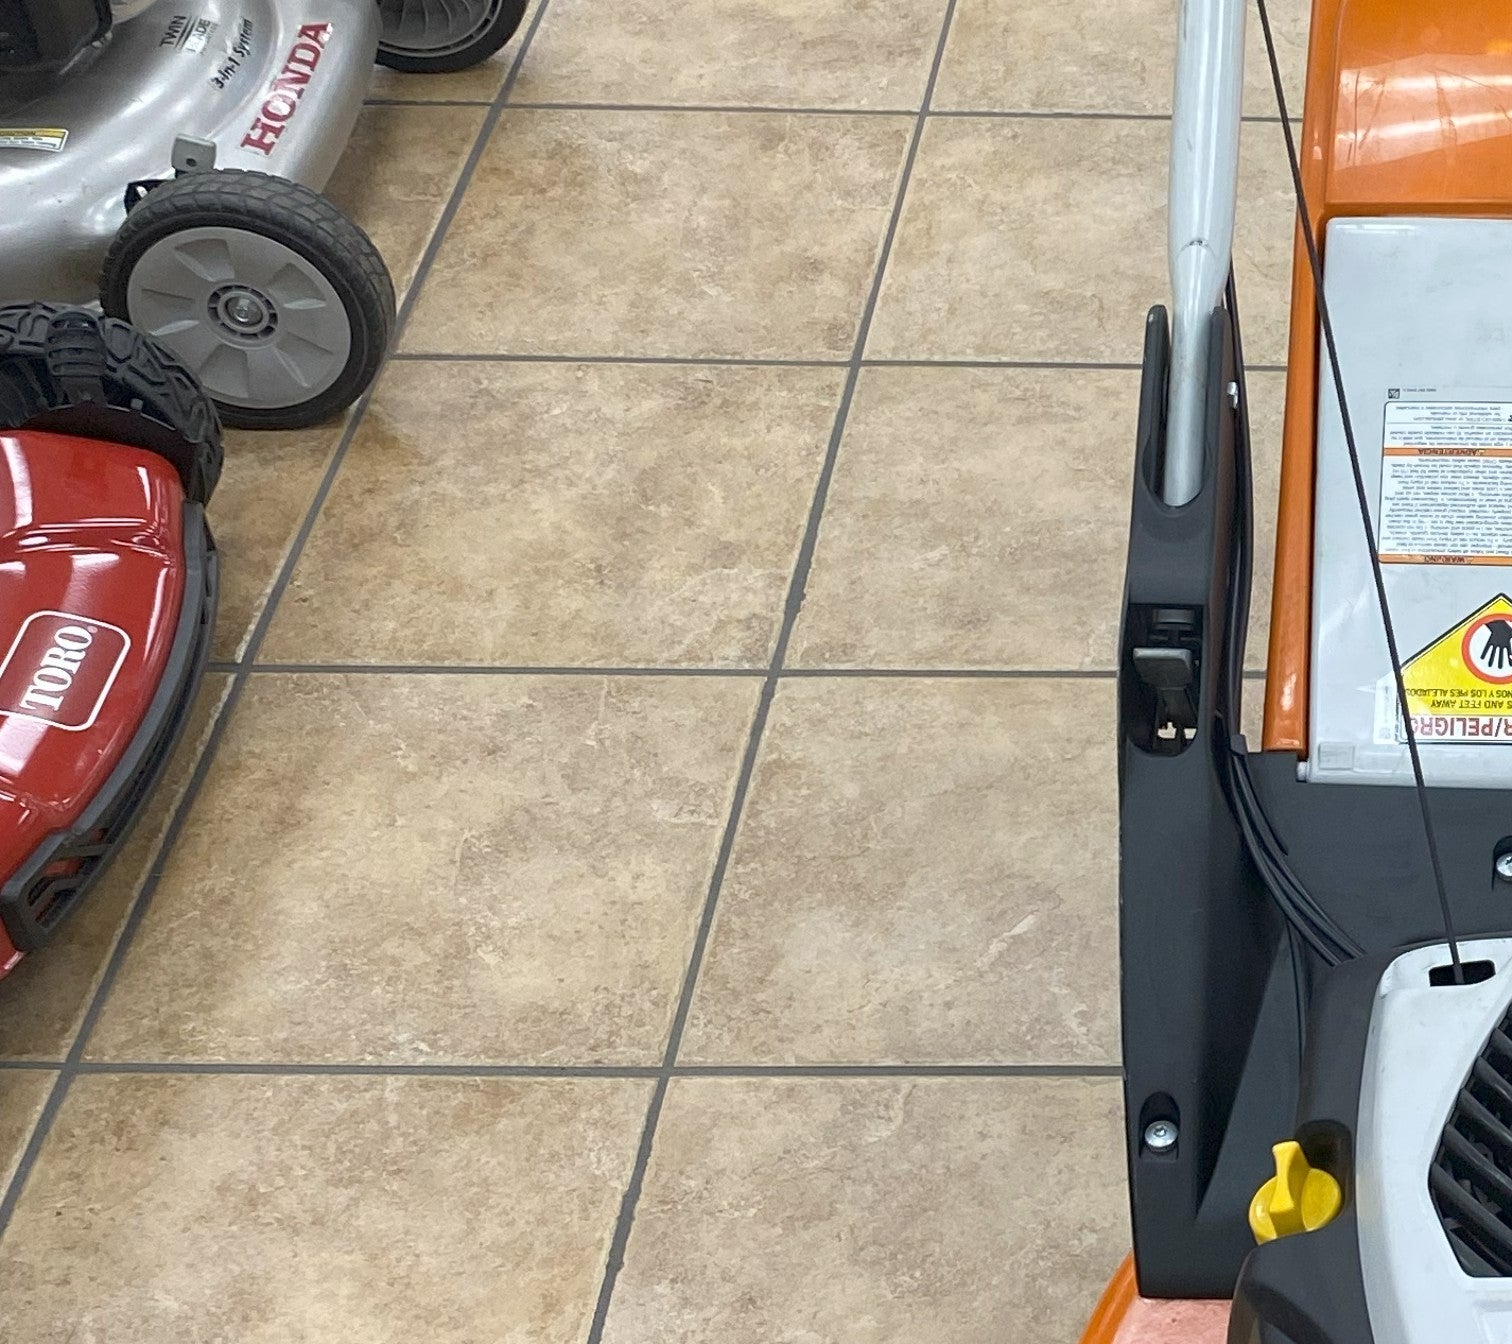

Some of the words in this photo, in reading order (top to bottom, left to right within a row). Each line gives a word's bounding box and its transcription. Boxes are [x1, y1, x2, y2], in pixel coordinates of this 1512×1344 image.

[160, 15, 187, 48] TWIN
[232, 18, 253, 58] System
[240, 22, 331, 156] HONDA
[20, 626, 93, 712] TORO
[1471, 690, 1488, 698] LOS
[1489, 690, 1495, 699] Y
[1430, 699, 1457, 708] AWAY
[1459, 700, 1482, 709] FEET
[1484, 701, 1503, 709] AND
